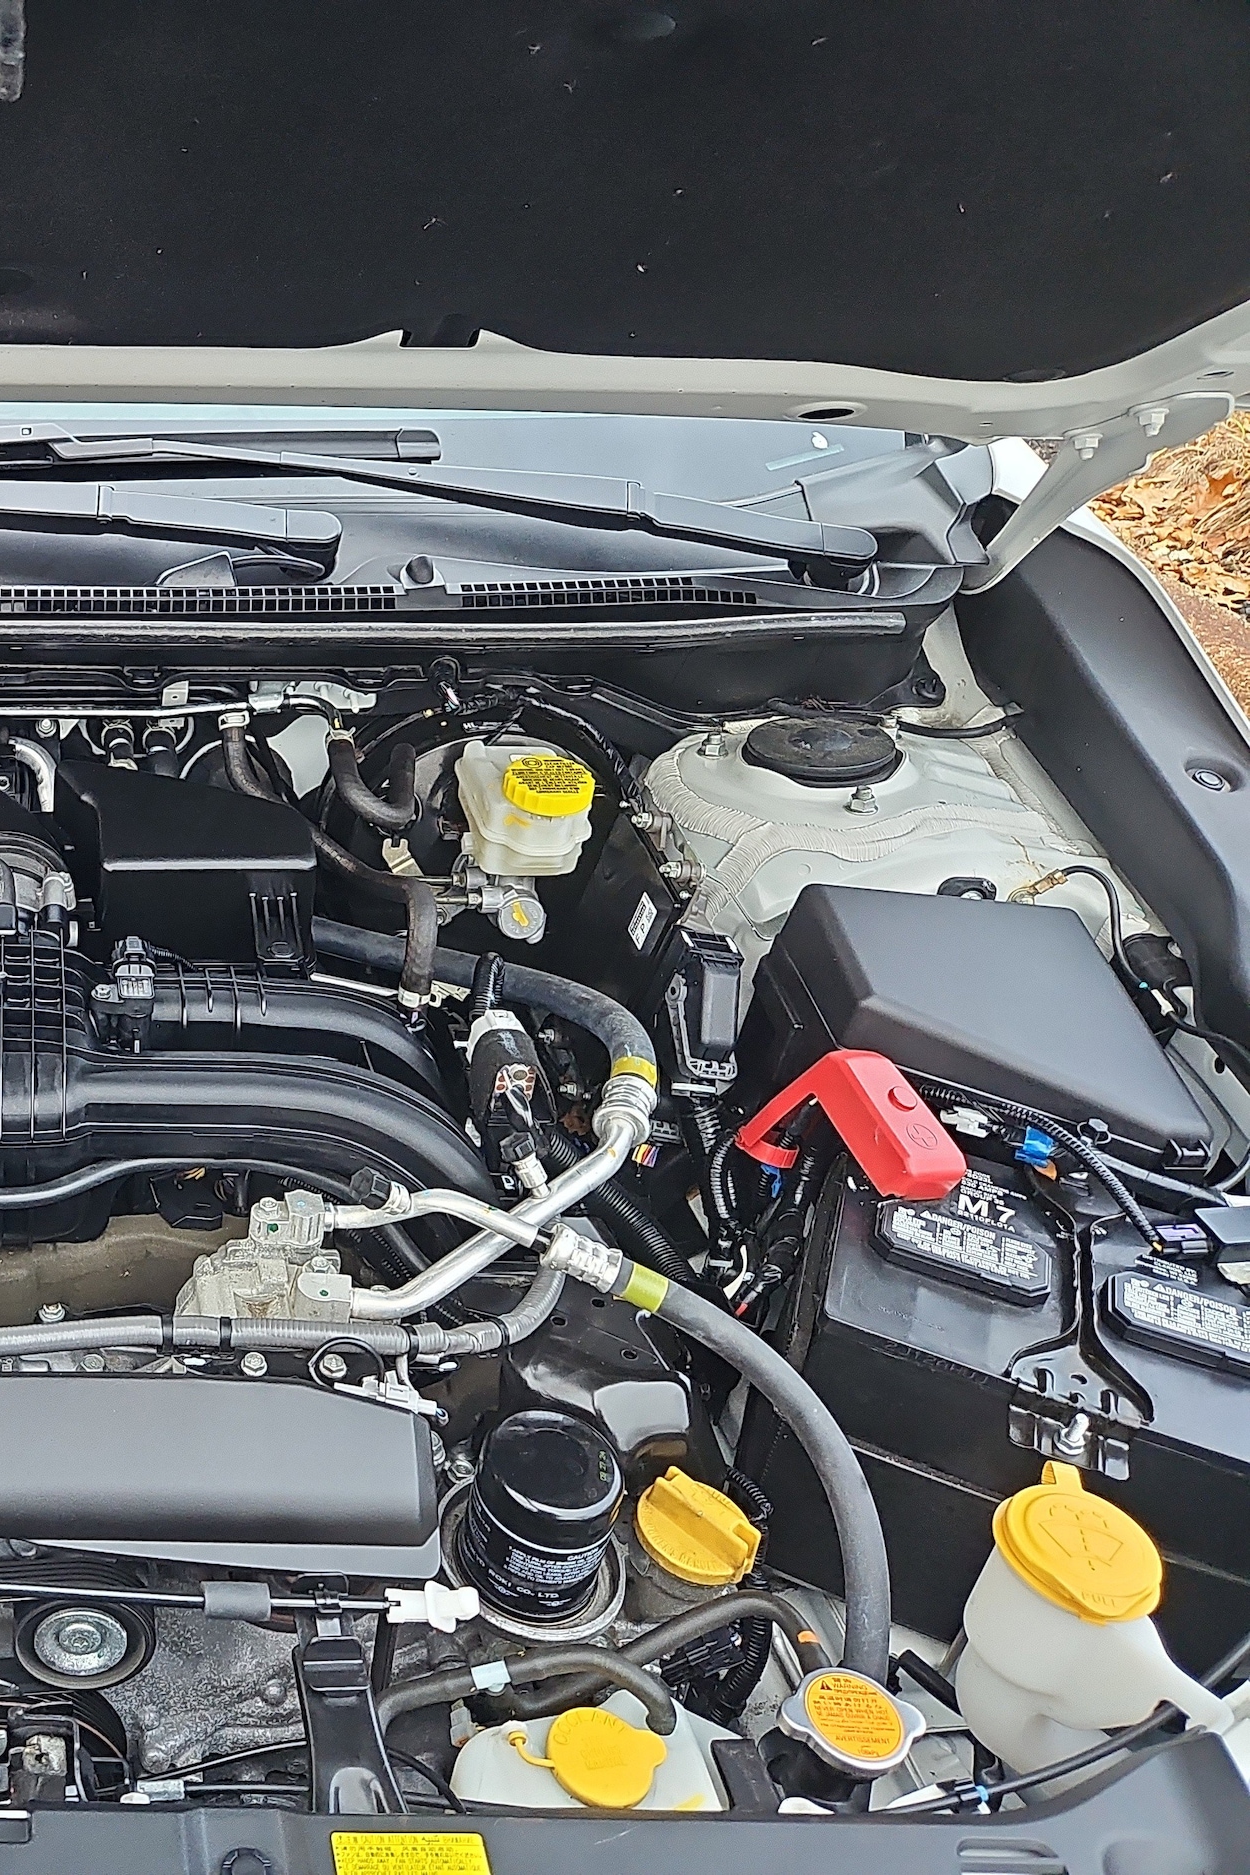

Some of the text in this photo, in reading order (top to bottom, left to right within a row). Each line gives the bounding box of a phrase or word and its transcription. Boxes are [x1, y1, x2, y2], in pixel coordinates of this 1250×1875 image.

[931, 1213, 996, 1240] DANGER/POISON
[1164, 1286, 1237, 1315] DANGER/POISON
[567, 1547, 599, 1561] CAUTION
[489, 1568, 511, 1588] ROKI
[553, 1710, 626, 1745] COOLANT
